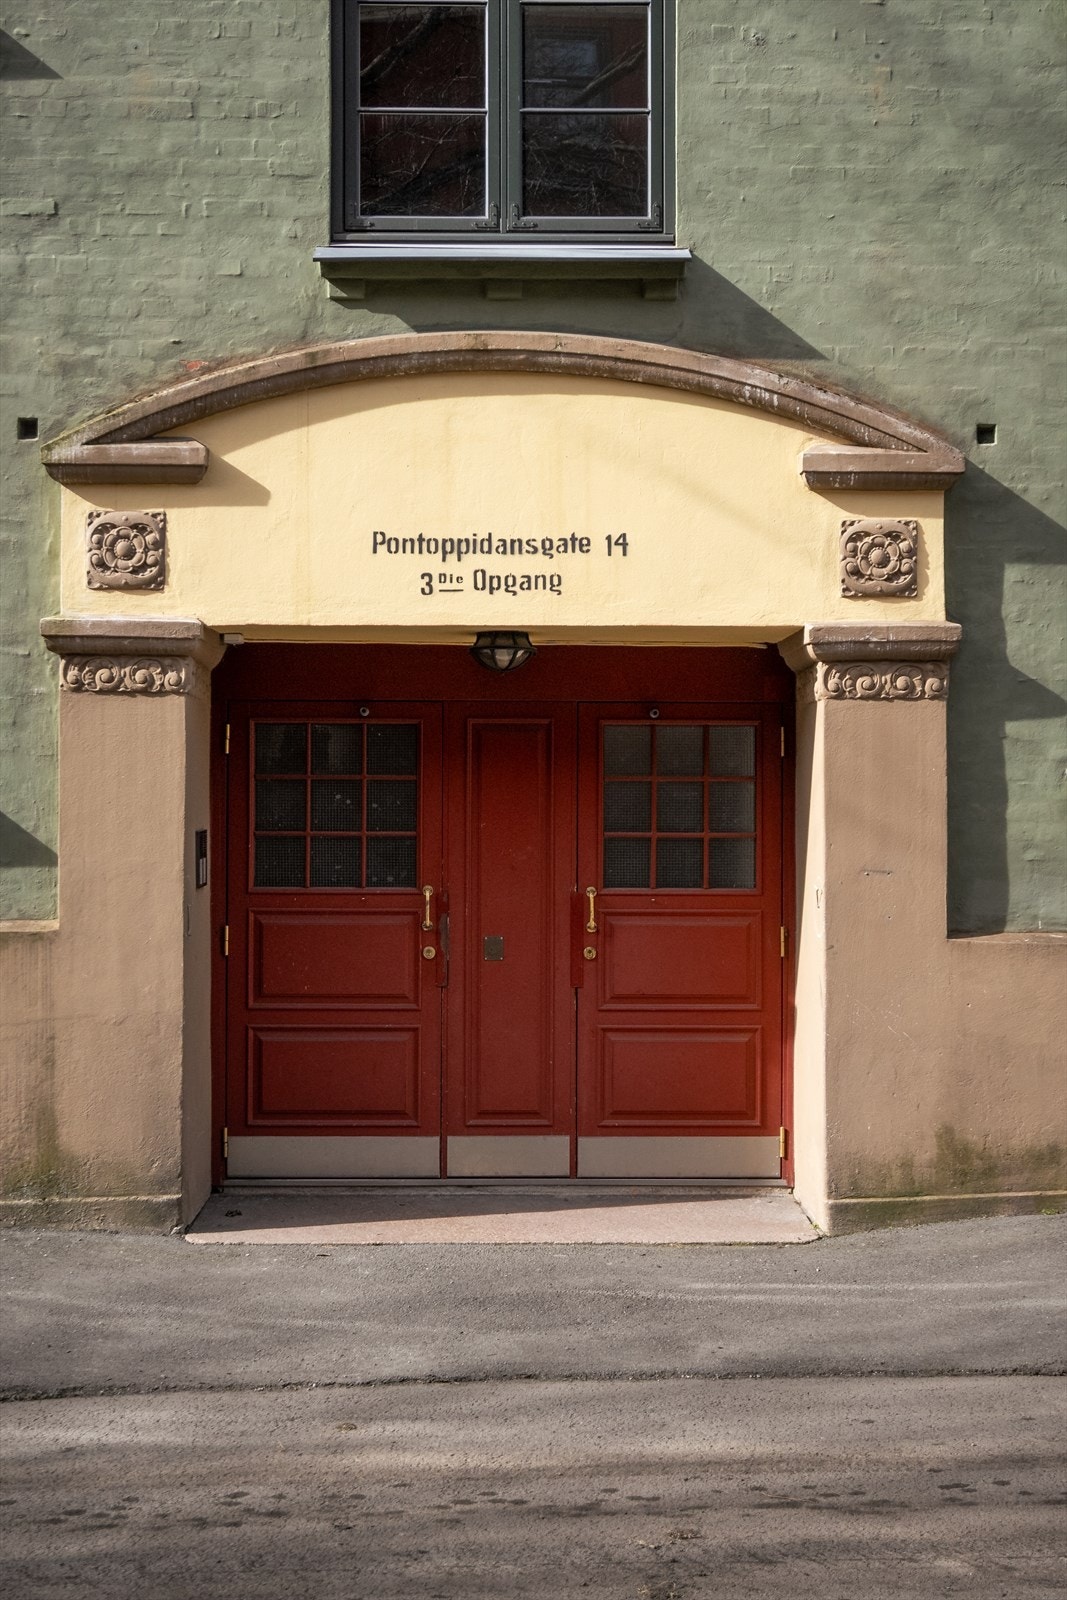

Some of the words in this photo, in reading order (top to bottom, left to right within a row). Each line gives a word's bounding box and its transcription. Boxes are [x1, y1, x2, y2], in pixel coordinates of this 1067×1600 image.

[372, 531, 591, 562] Pontoppidansgate
[605, 532, 629, 557] 14
[473, 568, 562, 597] Opgang
